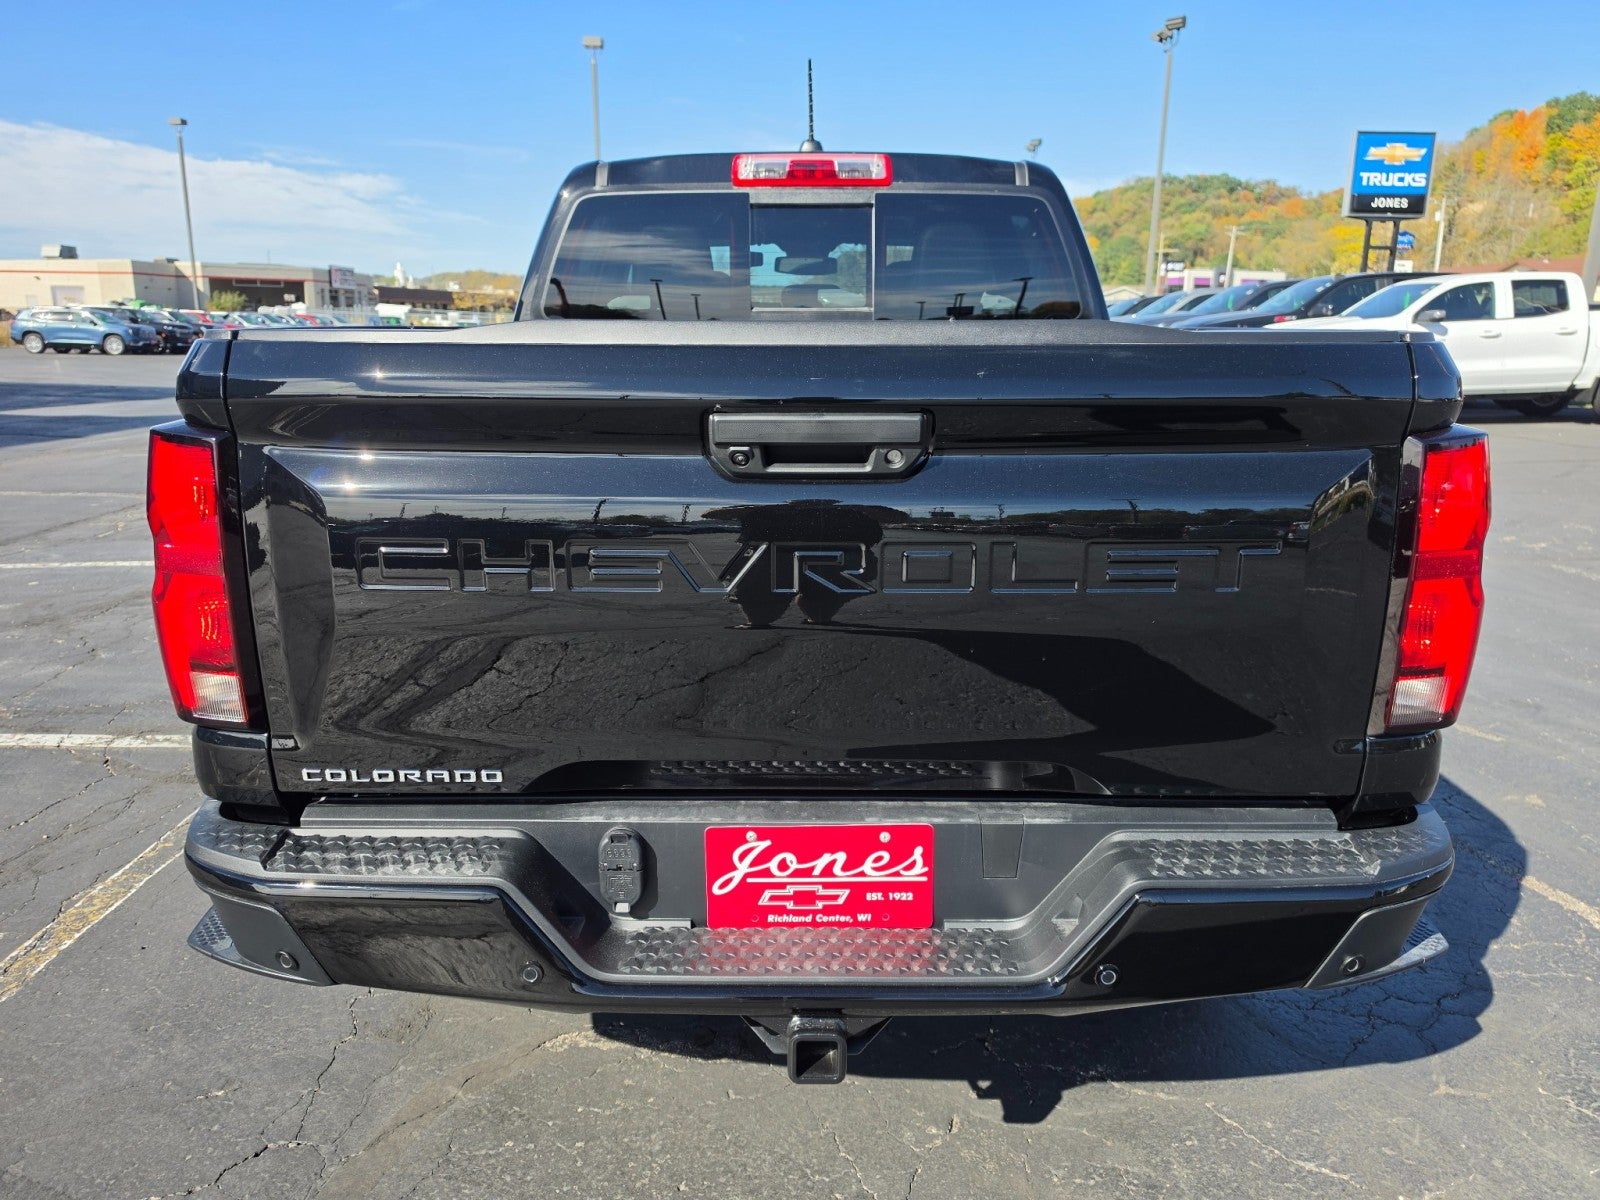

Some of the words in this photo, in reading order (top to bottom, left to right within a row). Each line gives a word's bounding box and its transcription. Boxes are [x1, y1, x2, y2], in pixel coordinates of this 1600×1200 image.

[1360, 171, 1427, 187] TRUCKS
[1371, 197, 1409, 209] JONES
[354, 537, 1284, 594] CHEVROLET
[301, 767, 504, 783] COLORADO
[711, 839, 929, 896] Jones
[866, 891, 885, 901] EST.
[888, 891, 914, 901] 1922
[767, 912, 813, 923] Richland
[815, 912, 854, 924] Center,
[857, 912, 872, 923] WI
